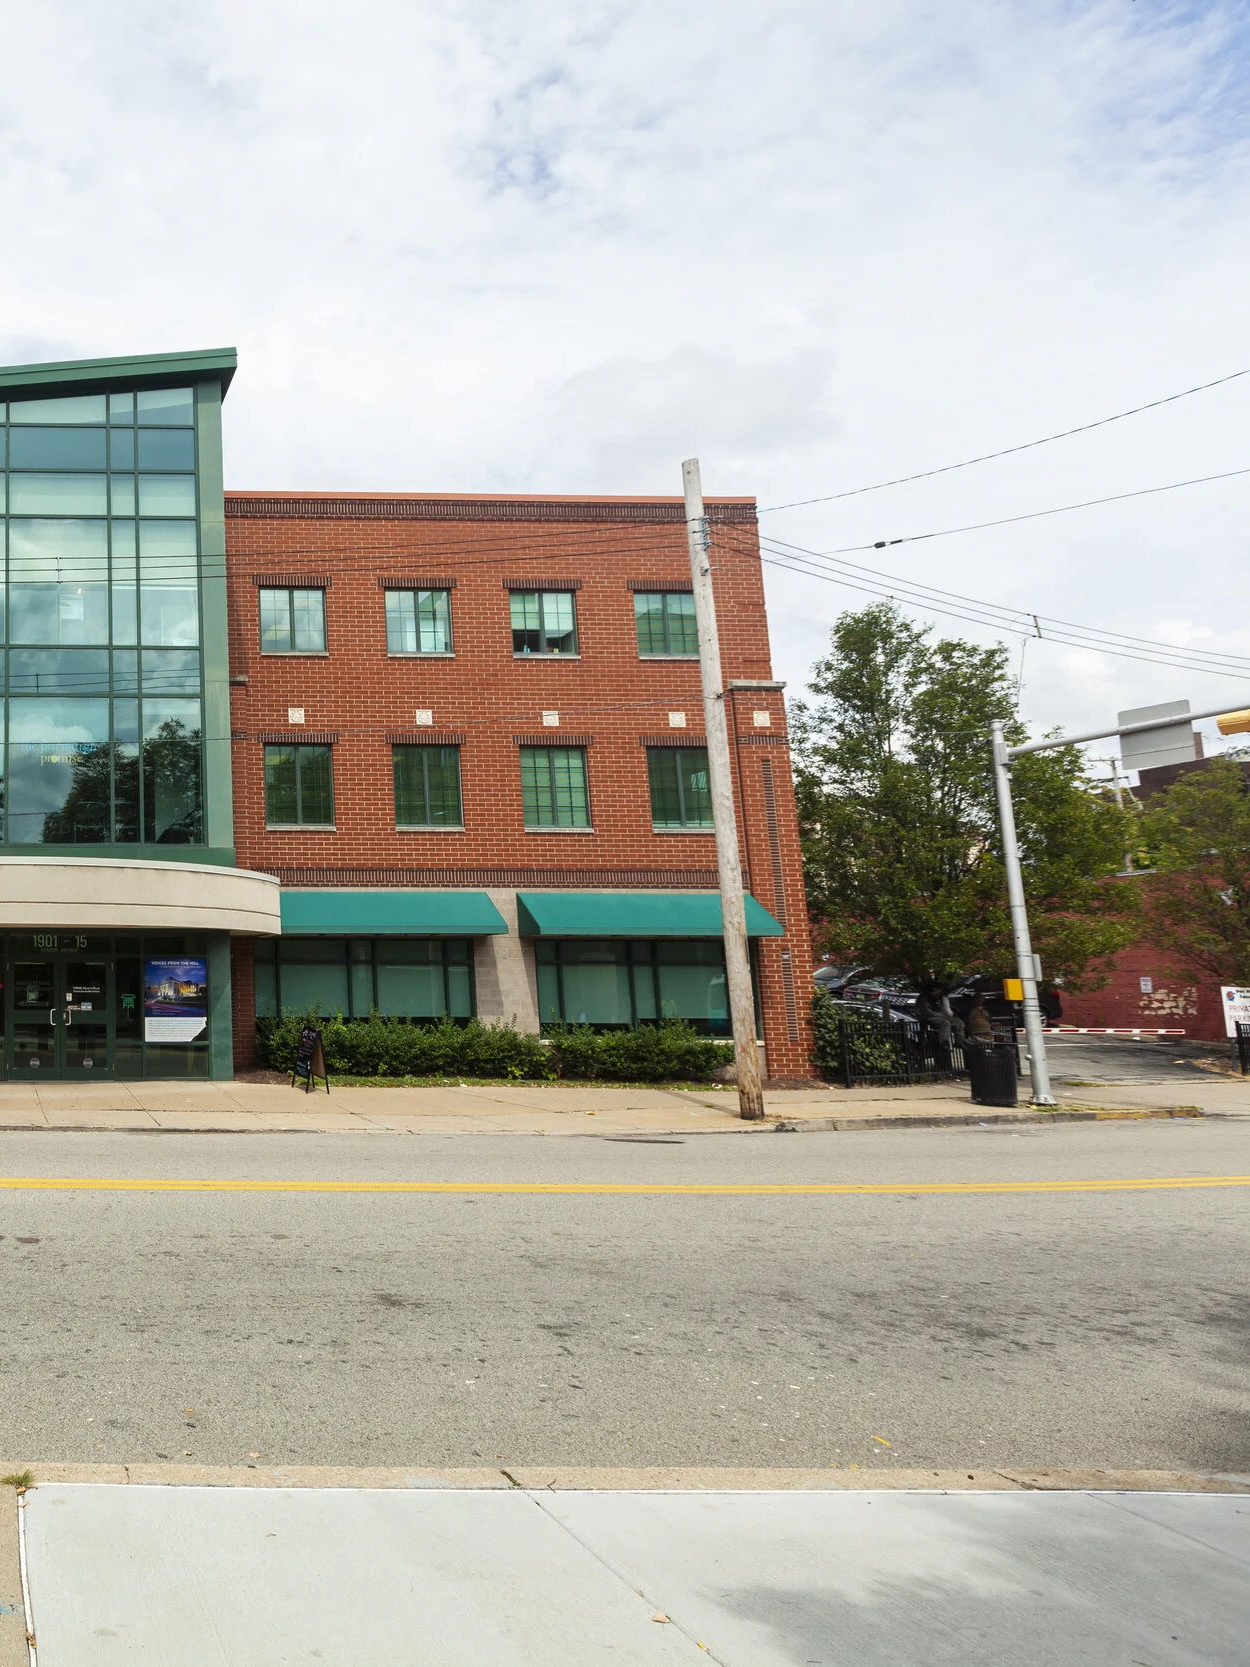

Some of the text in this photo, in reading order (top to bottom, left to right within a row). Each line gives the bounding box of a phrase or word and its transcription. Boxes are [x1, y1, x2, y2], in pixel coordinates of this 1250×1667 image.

[40, 755, 83, 766] promise
[33, 935, 58, 947] 1901
[75, 935, 87, 948] 15
